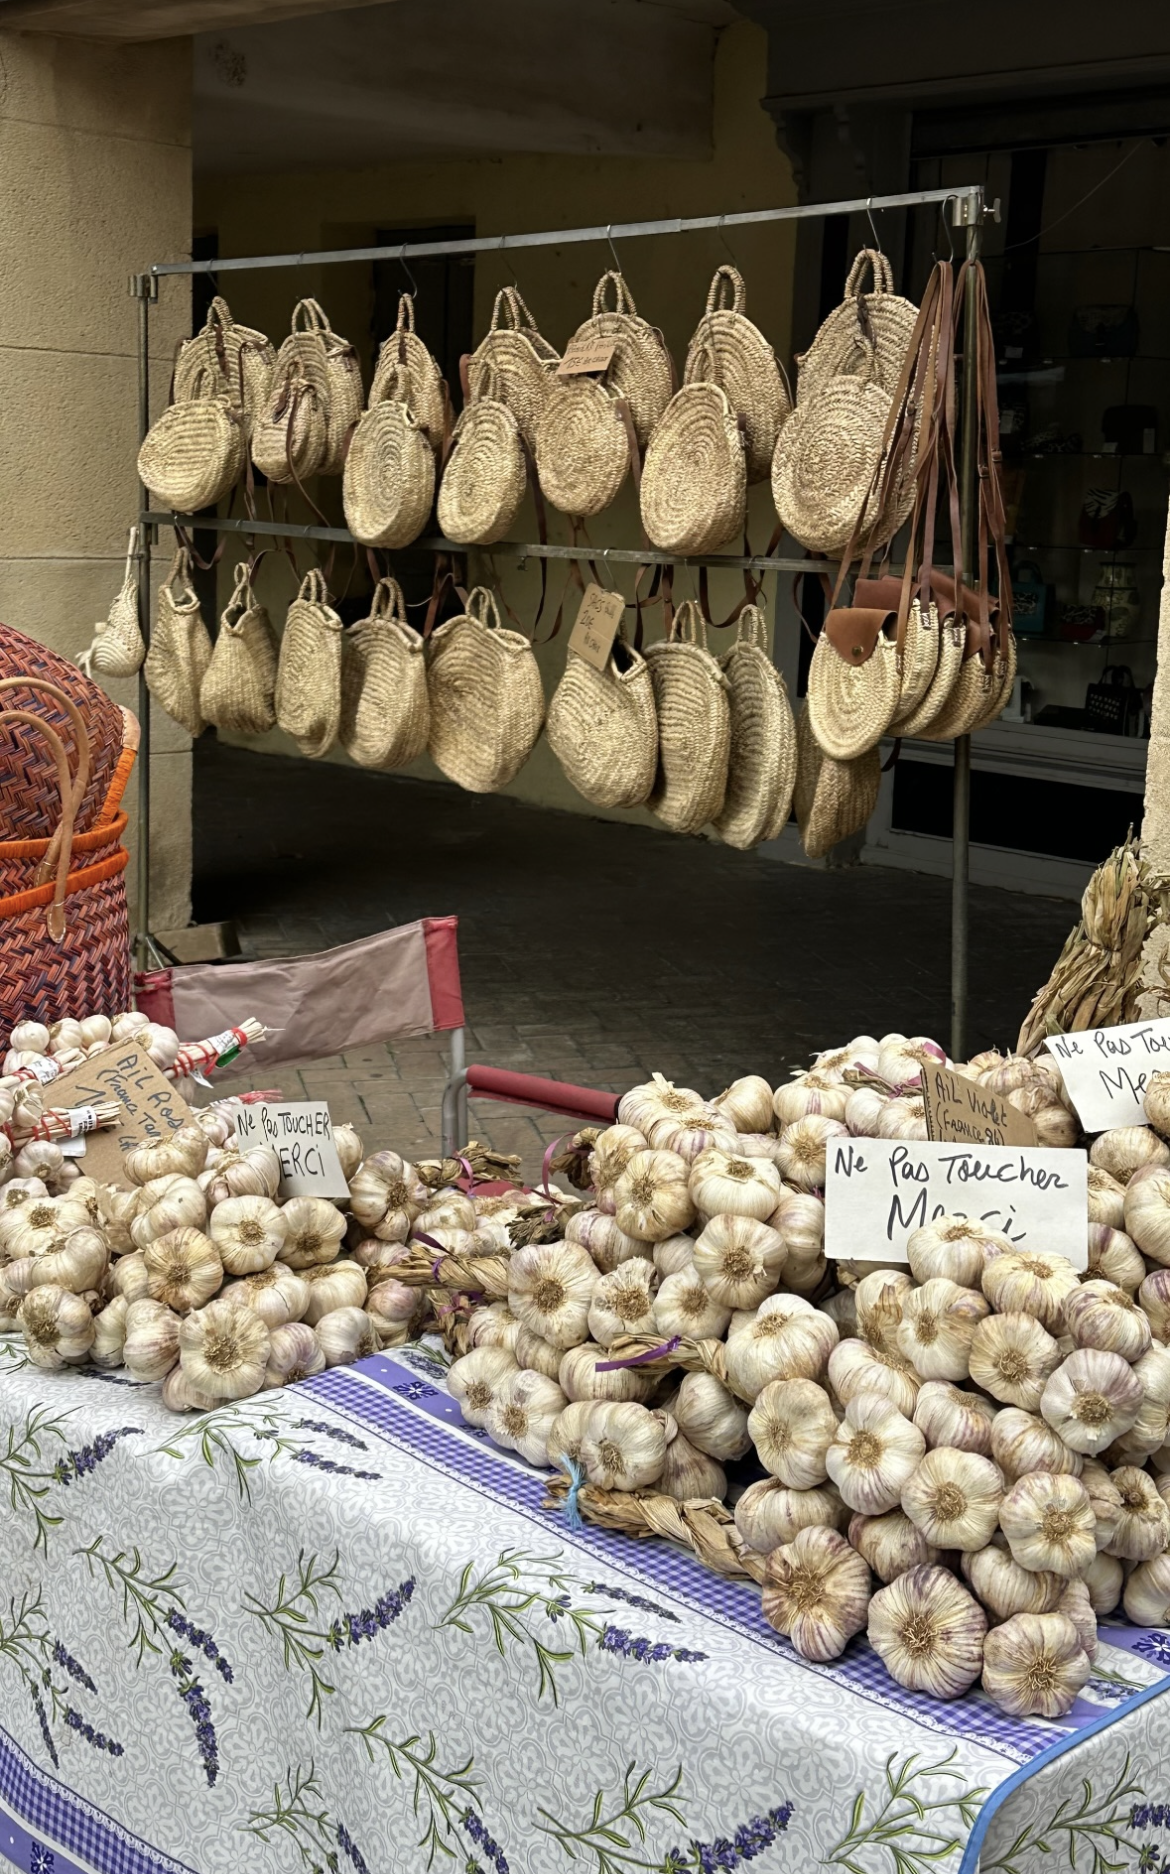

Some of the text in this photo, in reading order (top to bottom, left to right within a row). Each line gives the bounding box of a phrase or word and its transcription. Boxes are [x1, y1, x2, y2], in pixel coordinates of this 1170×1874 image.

[1055, 1027, 1170, 1058] Ne Pas Tou
[1098, 1066, 1161, 1105] Me
[146, 1091, 185, 1129] Ros
[236, 1108, 256, 1137] Ne
[277, 1111, 331, 1141] TOUCHER
[834, 1145, 1070, 1191] Ne Pas Toucher
